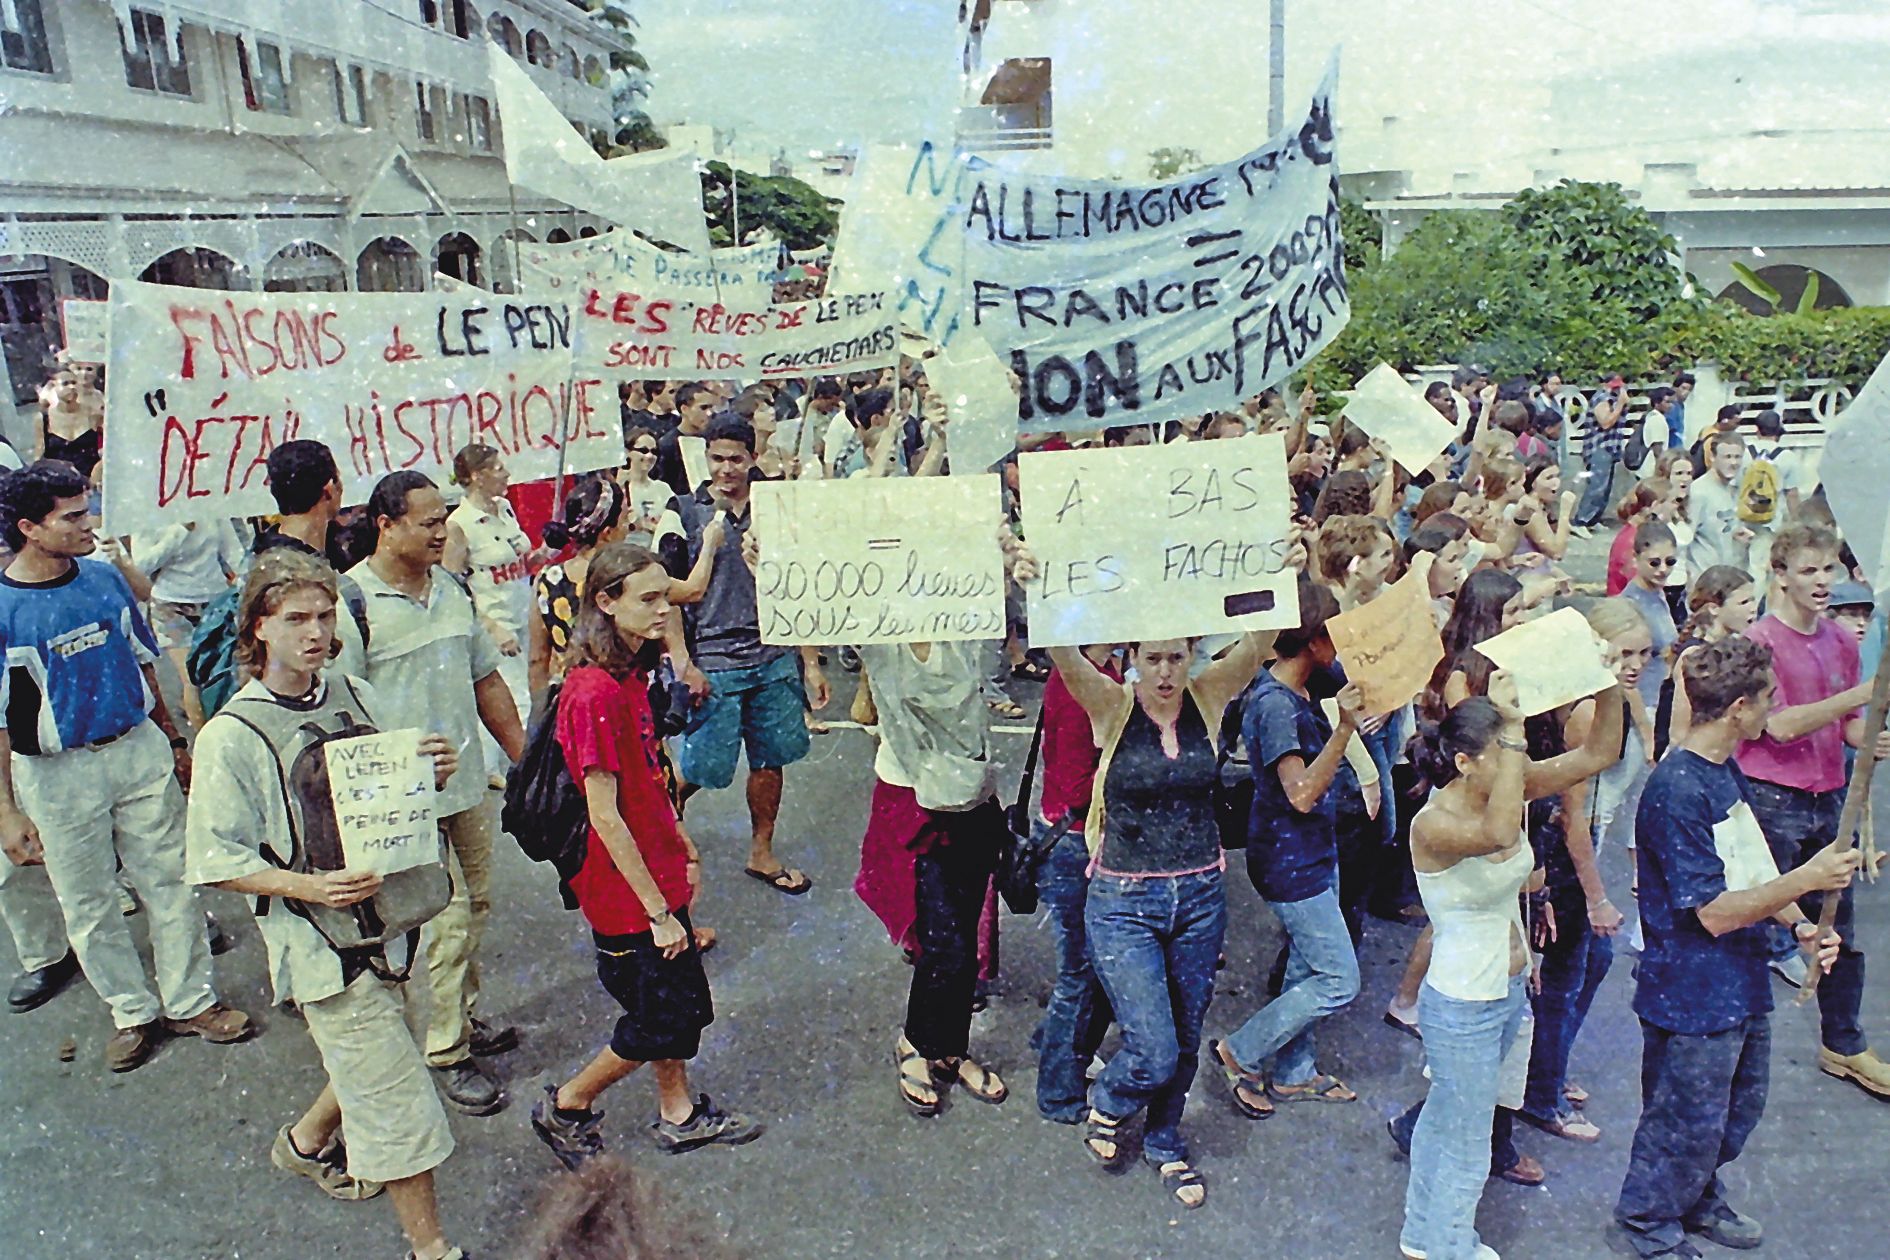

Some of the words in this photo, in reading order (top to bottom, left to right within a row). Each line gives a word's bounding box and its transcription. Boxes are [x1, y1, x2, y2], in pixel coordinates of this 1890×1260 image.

[967, 176, 1226, 242] ALLEMAGNE
[584, 288, 672, 335] LES
[776, 305, 808, 330] DE
[815, 300, 838, 324] LE
[844, 291, 885, 316] PEN
[973, 279, 1221, 328] FRANCE
[169, 298, 346, 381] FAISONS
[383, 325, 424, 363] de
[437, 306, 490, 357] LE
[504, 303, 571, 350] PEN
[604, 341, 676, 370] SONT
[696, 348, 747, 371] NOS
[1153, 349, 1233, 400] AUX
[1168, 467, 1258, 519] BAS
[1041, 555, 1124, 599] LES
[1164, 539, 1285, 581] FACHOS
[330, 742, 385, 766] AVEC
[343, 810, 400, 830] PEINE
[362, 834, 414, 853] MORT
